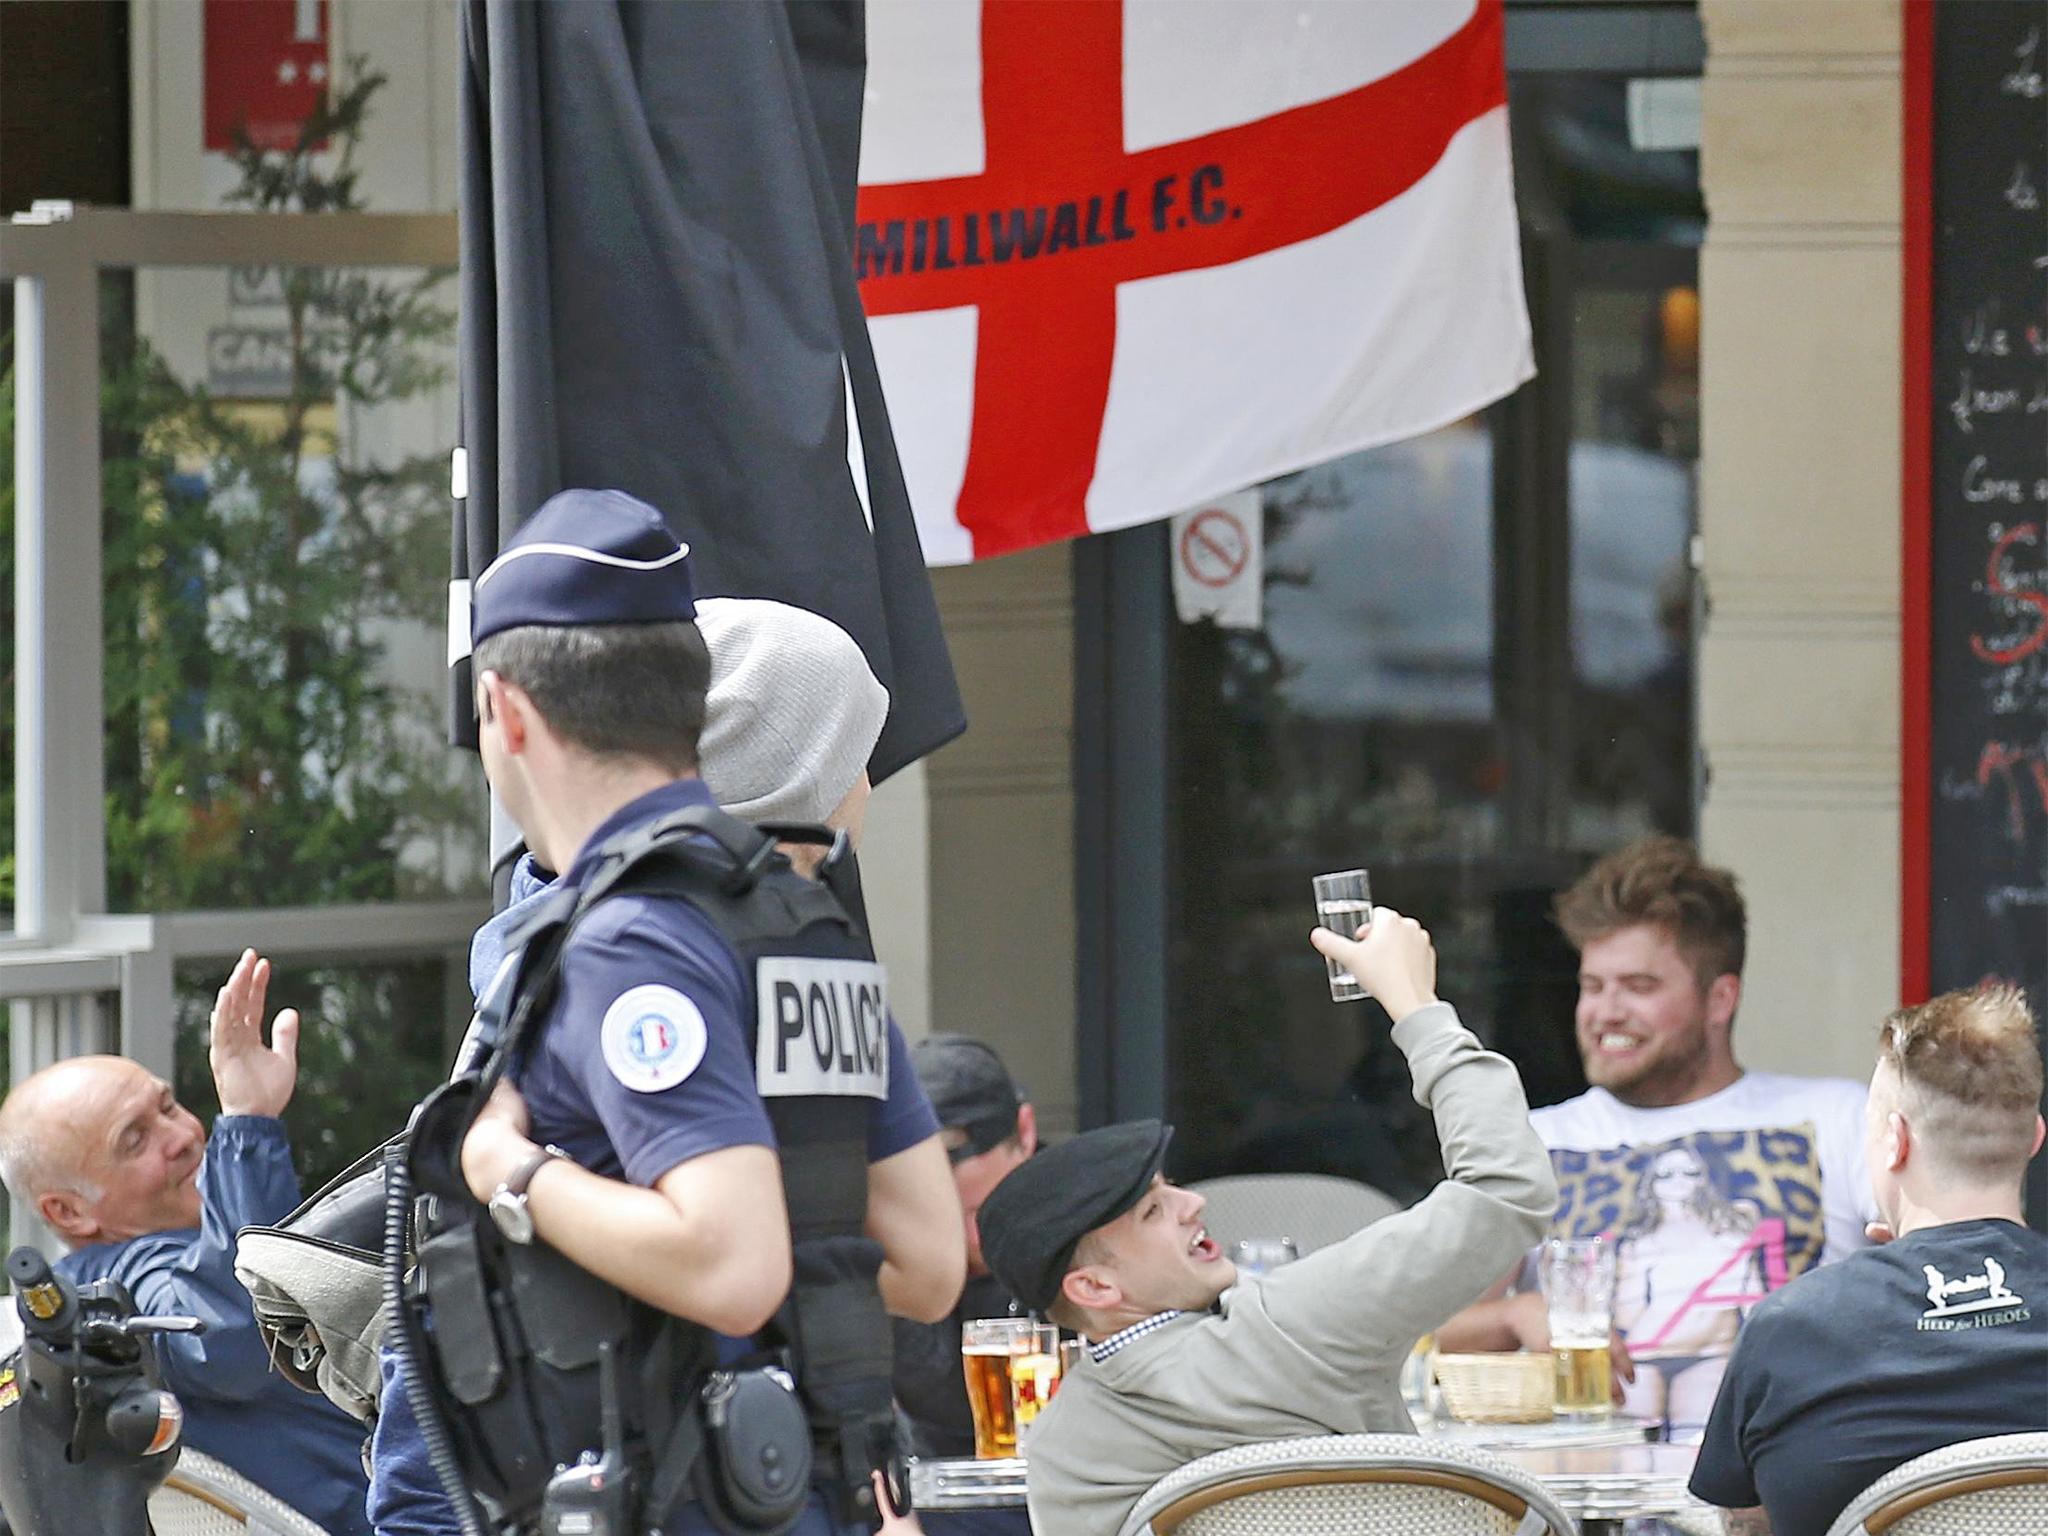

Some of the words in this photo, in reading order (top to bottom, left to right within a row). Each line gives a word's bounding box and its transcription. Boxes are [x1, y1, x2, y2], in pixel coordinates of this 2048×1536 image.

[857, 189, 1135, 280] MILLWALL
[1152, 163, 1243, 233] F.C.
[1916, 1317, 1955, 1331] HELP
[1974, 1308, 2031, 1329] HEROES
